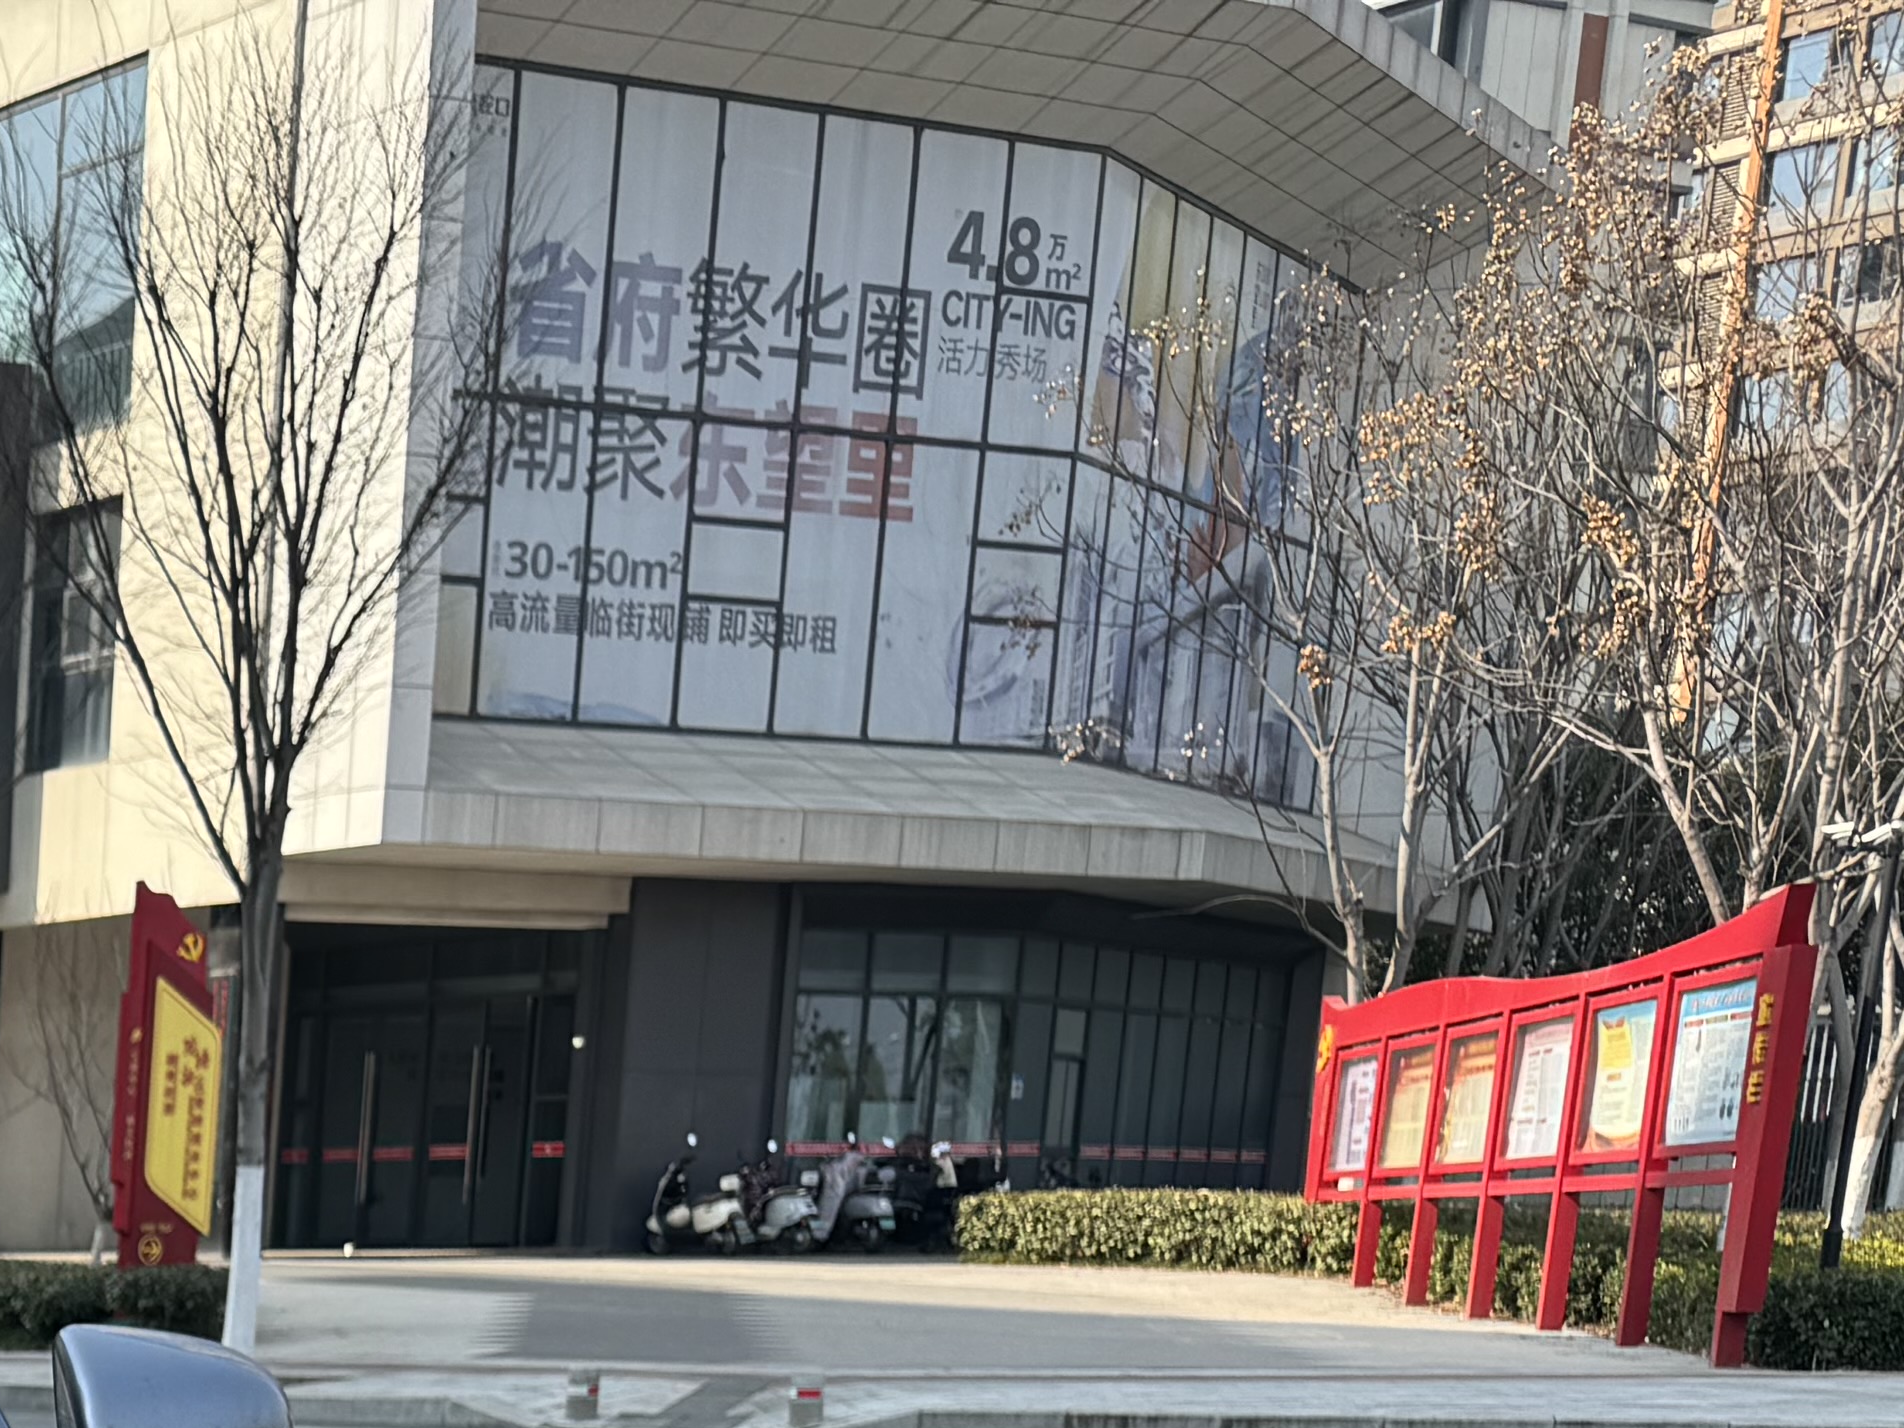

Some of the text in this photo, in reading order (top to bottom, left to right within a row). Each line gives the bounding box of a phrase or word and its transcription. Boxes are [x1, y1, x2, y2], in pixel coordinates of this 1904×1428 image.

[947, 210, 1041, 285] 4.8
[1048, 234, 1067, 261] 万
[507, 238, 932, 400] 省府繁华圈
[941, 290, 1076, 341] CITY-ING
[937, 335, 1048, 383] 活力秀场
[494, 374, 919, 523] 潮聚东望里
